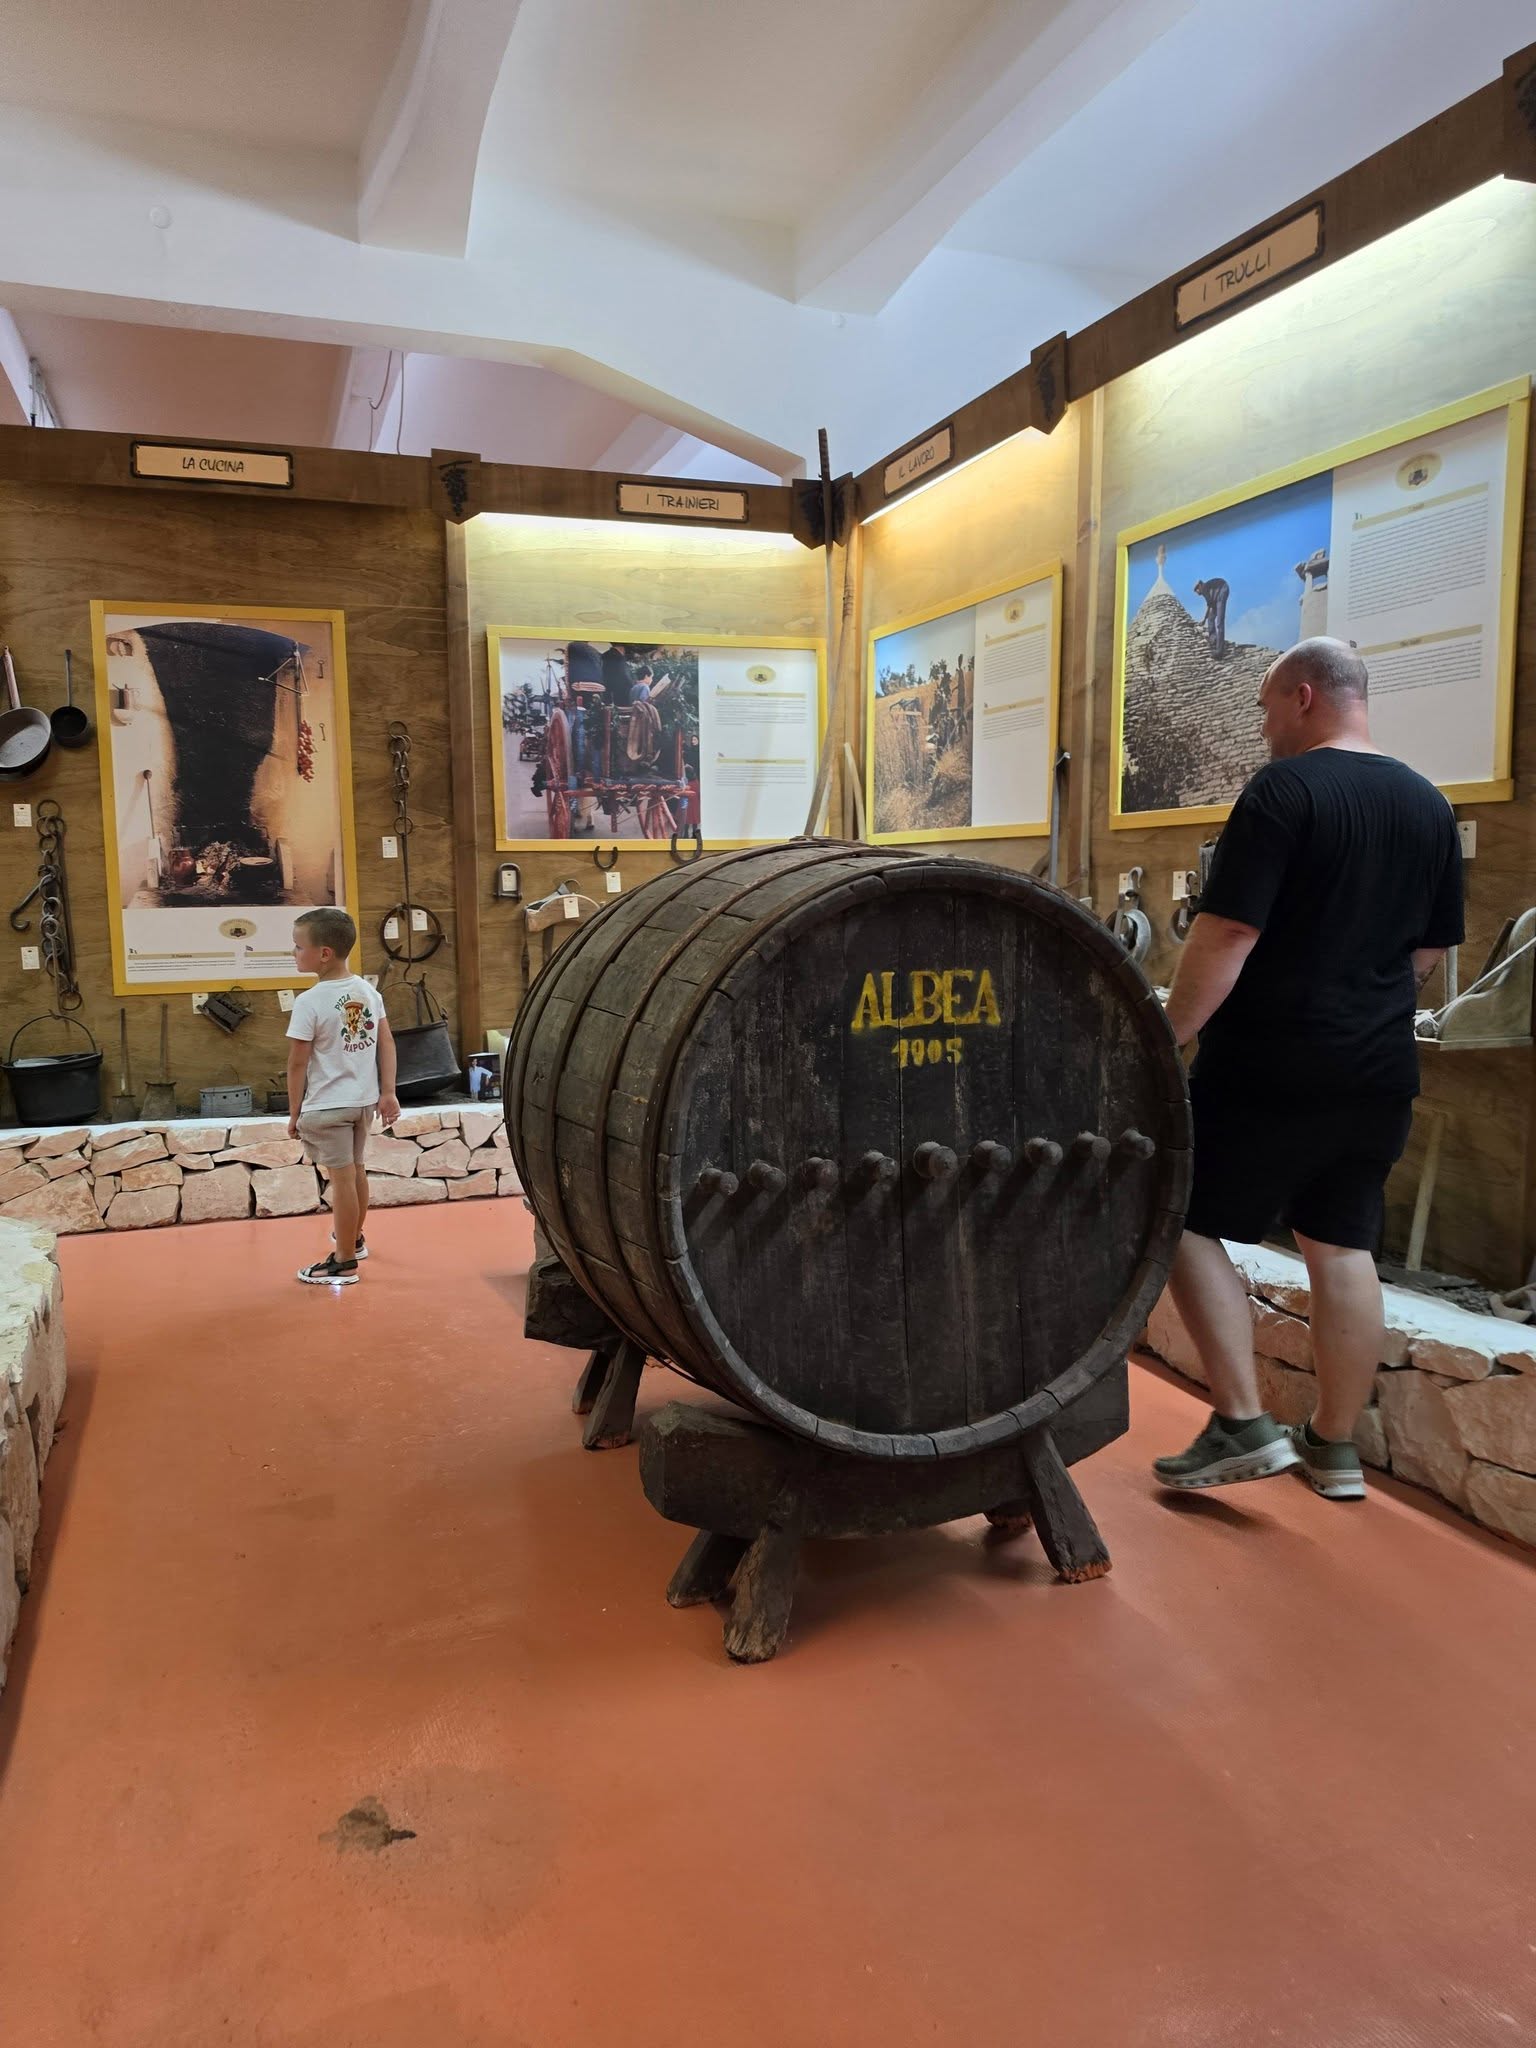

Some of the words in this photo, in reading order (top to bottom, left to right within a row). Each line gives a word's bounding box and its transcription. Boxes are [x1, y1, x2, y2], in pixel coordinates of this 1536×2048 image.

[1215, 247, 1271, 293] TRULLI
[182, 456, 195, 470] LA
[199, 457, 244, 473] CUCINA
[657, 493, 719, 511] TRAINIERI
[334, 993, 352, 1012] PIZZA
[851, 969, 1001, 1032] ALBEA
[343, 1036, 376, 1053] NAPOLI
